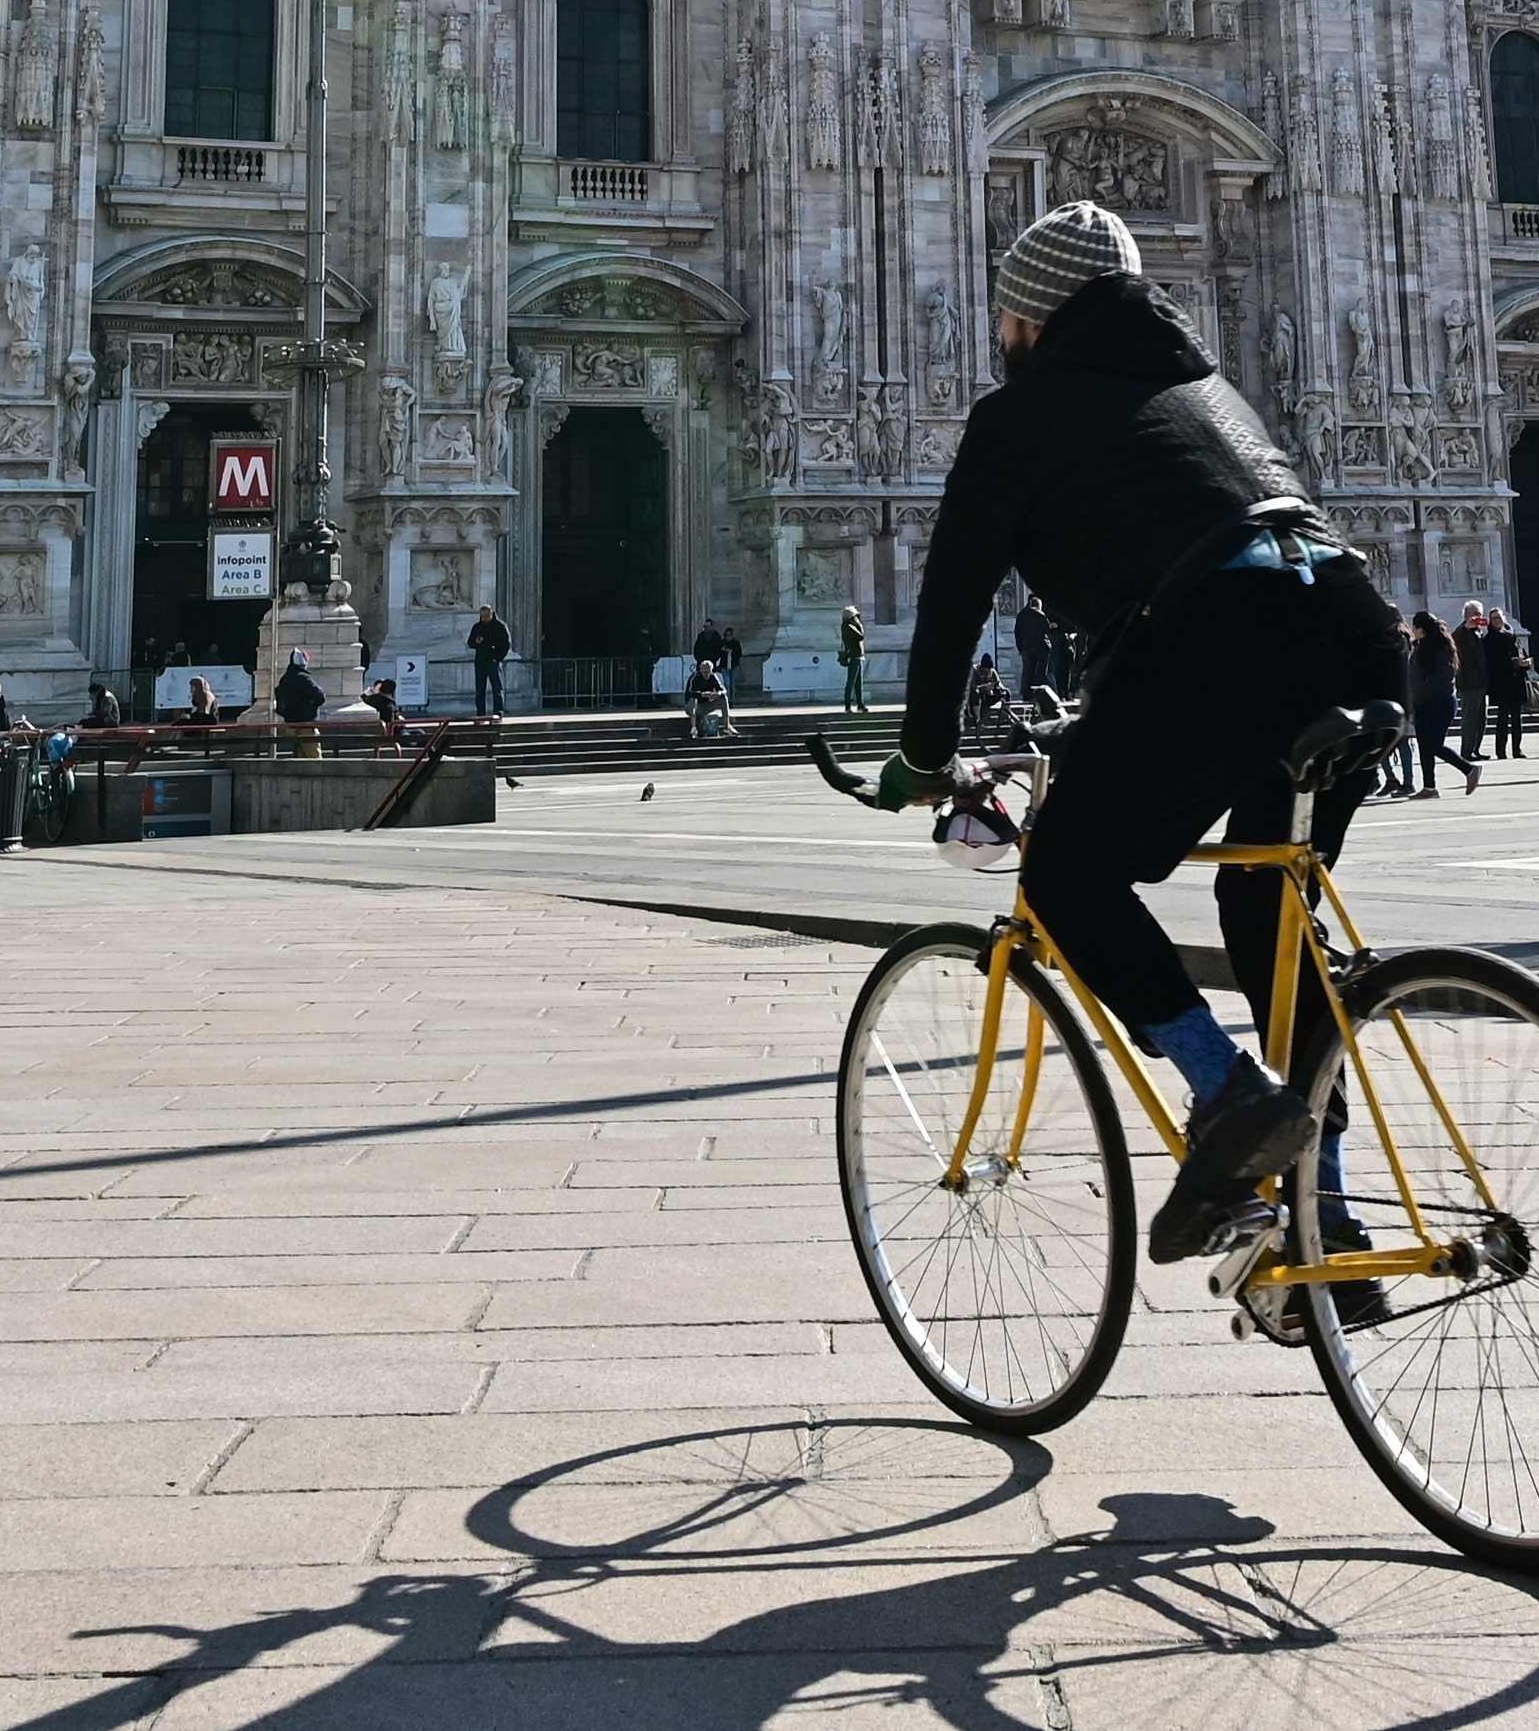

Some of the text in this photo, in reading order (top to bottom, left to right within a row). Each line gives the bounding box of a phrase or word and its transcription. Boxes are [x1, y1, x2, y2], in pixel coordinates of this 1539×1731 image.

[219, 456, 269, 497] M
[221, 569, 262, 580] Area B
[221, 585, 250, 594] Area
